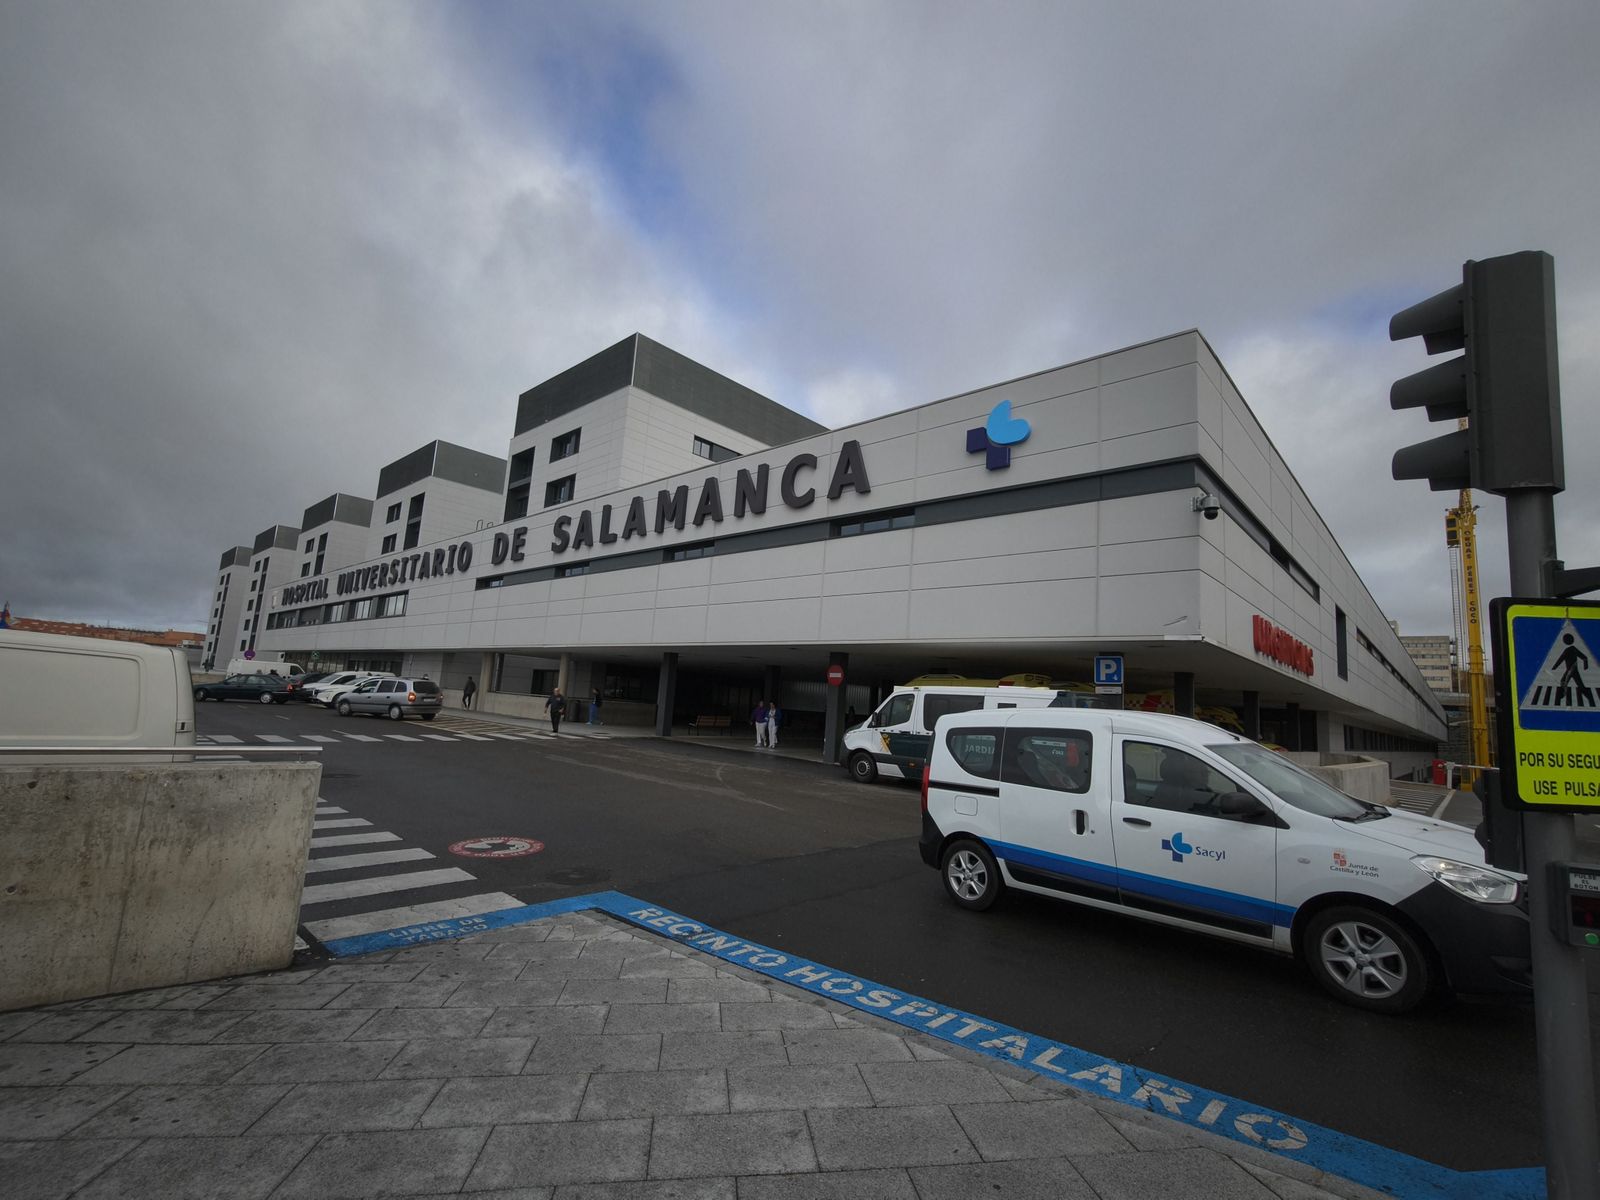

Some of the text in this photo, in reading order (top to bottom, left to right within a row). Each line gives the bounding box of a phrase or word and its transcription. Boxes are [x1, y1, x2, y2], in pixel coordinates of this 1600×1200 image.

[281, 440, 871, 606] HOSPITAL UNIVERSITARIO DE SALAMANCA
[1100, 660, 1117, 681] P
[1519, 752, 1600, 769] POR SU SEGU
[1533, 780, 1559, 796] USE
[1195, 846, 1226, 861] Sacyl
[1329, 866, 1354, 874] Castilla
[1361, 870, 1379, 878] León
[627, 907, 1309, 1152] RECINTO HOSPITALARIO
